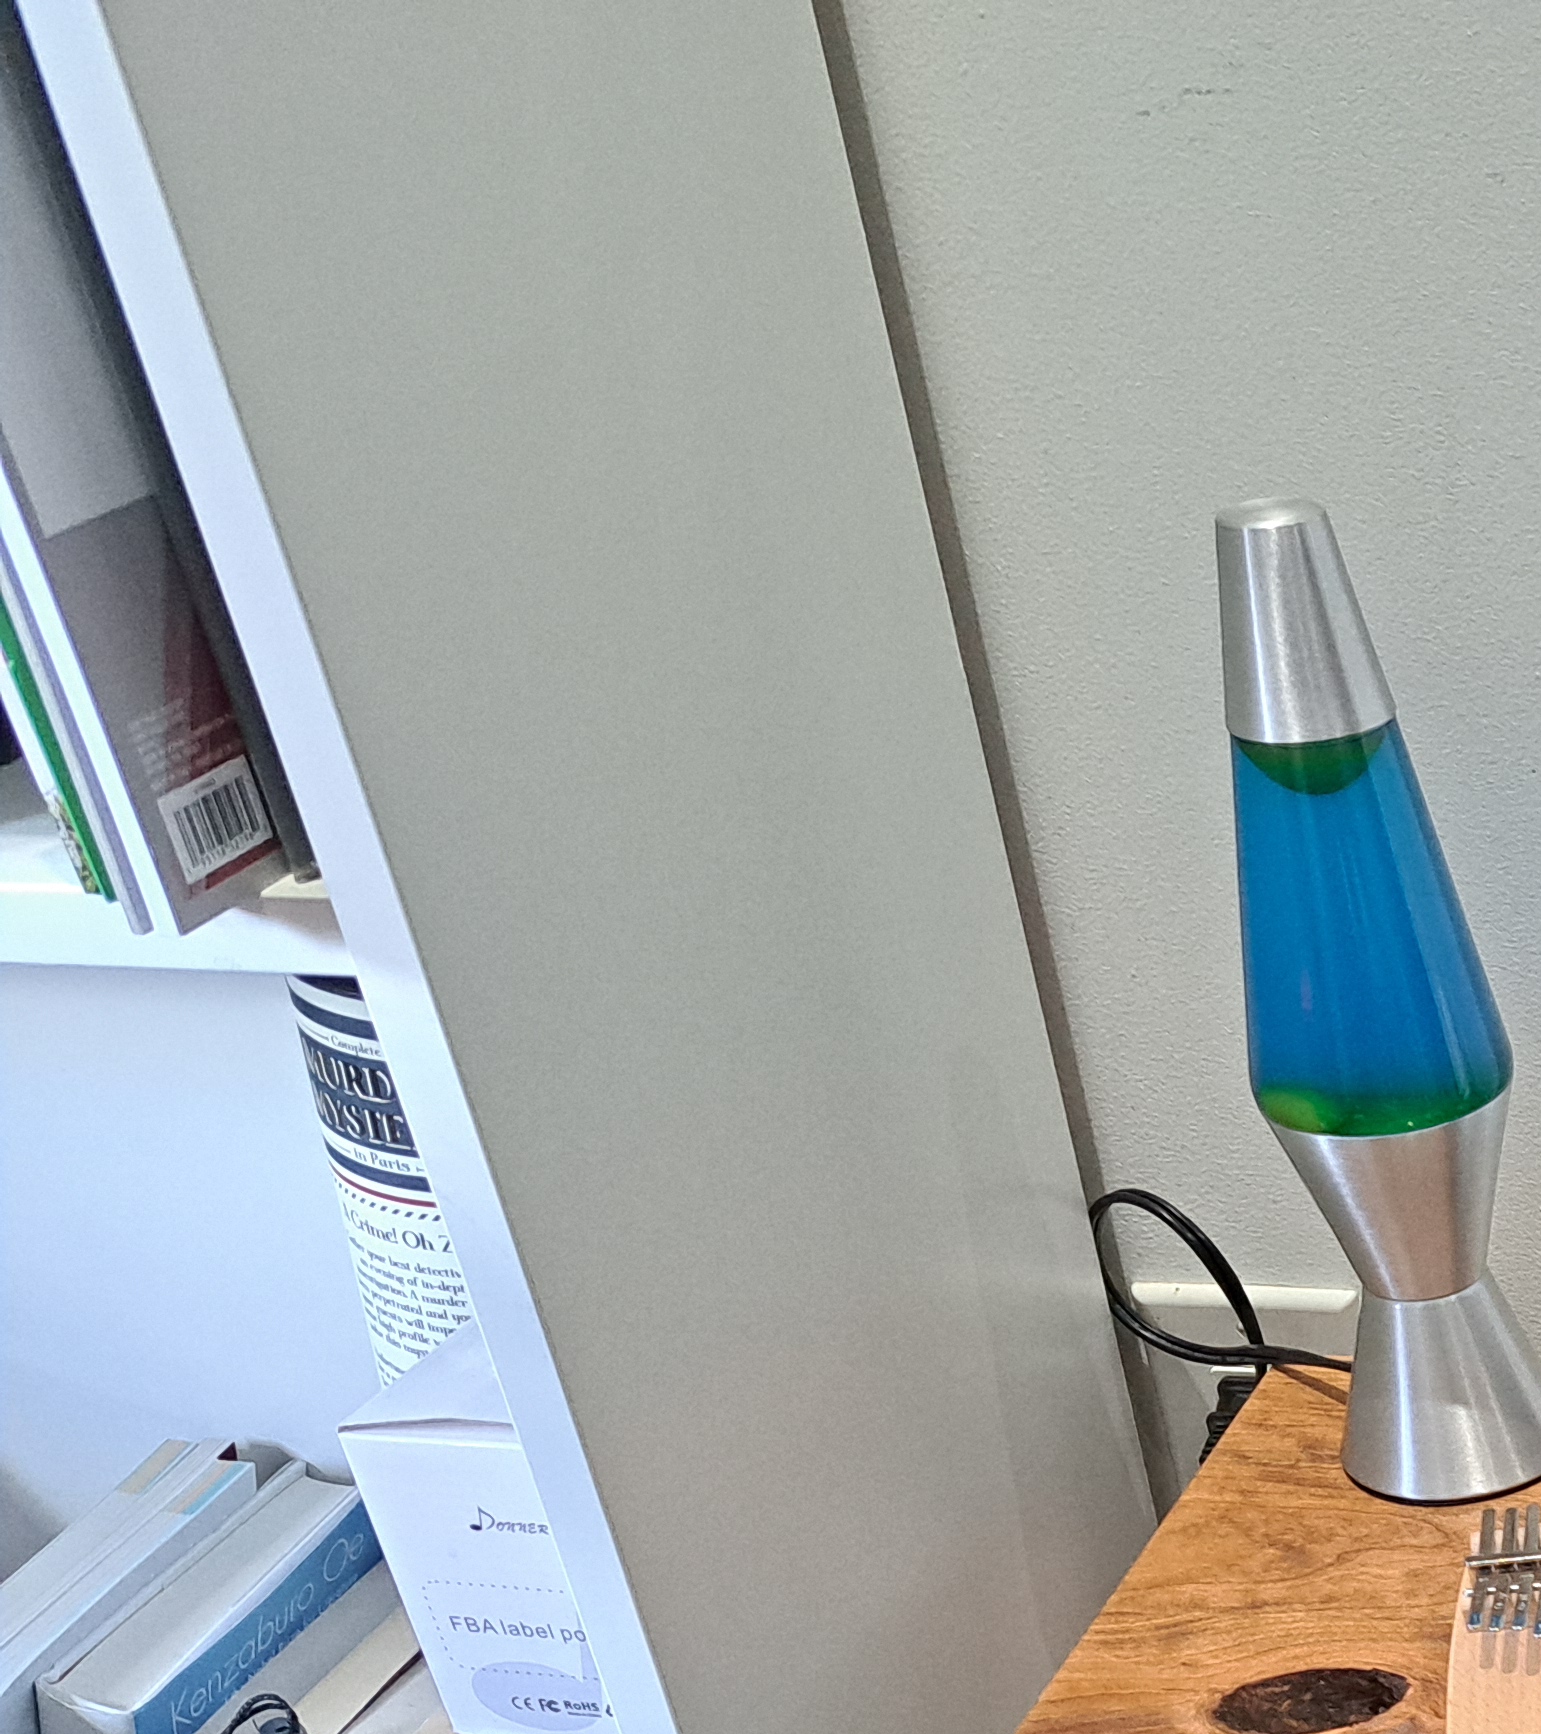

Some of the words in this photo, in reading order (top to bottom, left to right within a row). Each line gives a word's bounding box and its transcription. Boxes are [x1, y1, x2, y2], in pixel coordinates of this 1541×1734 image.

[331, 1035, 381, 1057] Complete
[302, 1037, 393, 1104] MURD
[312, 1080, 415, 1151] MYSTE
[370, 1151, 411, 1173] Parts
[402, 1230, 435, 1252] Oh
[414, 1263, 462, 1279] detectiv
[421, 1279, 465, 1297] in-dept
[323, 1533, 364, 1582] Oe
[449, 1616, 498, 1635] FBA
[499, 1619, 554, 1640] label
[560, 1628, 587, 1644] po
